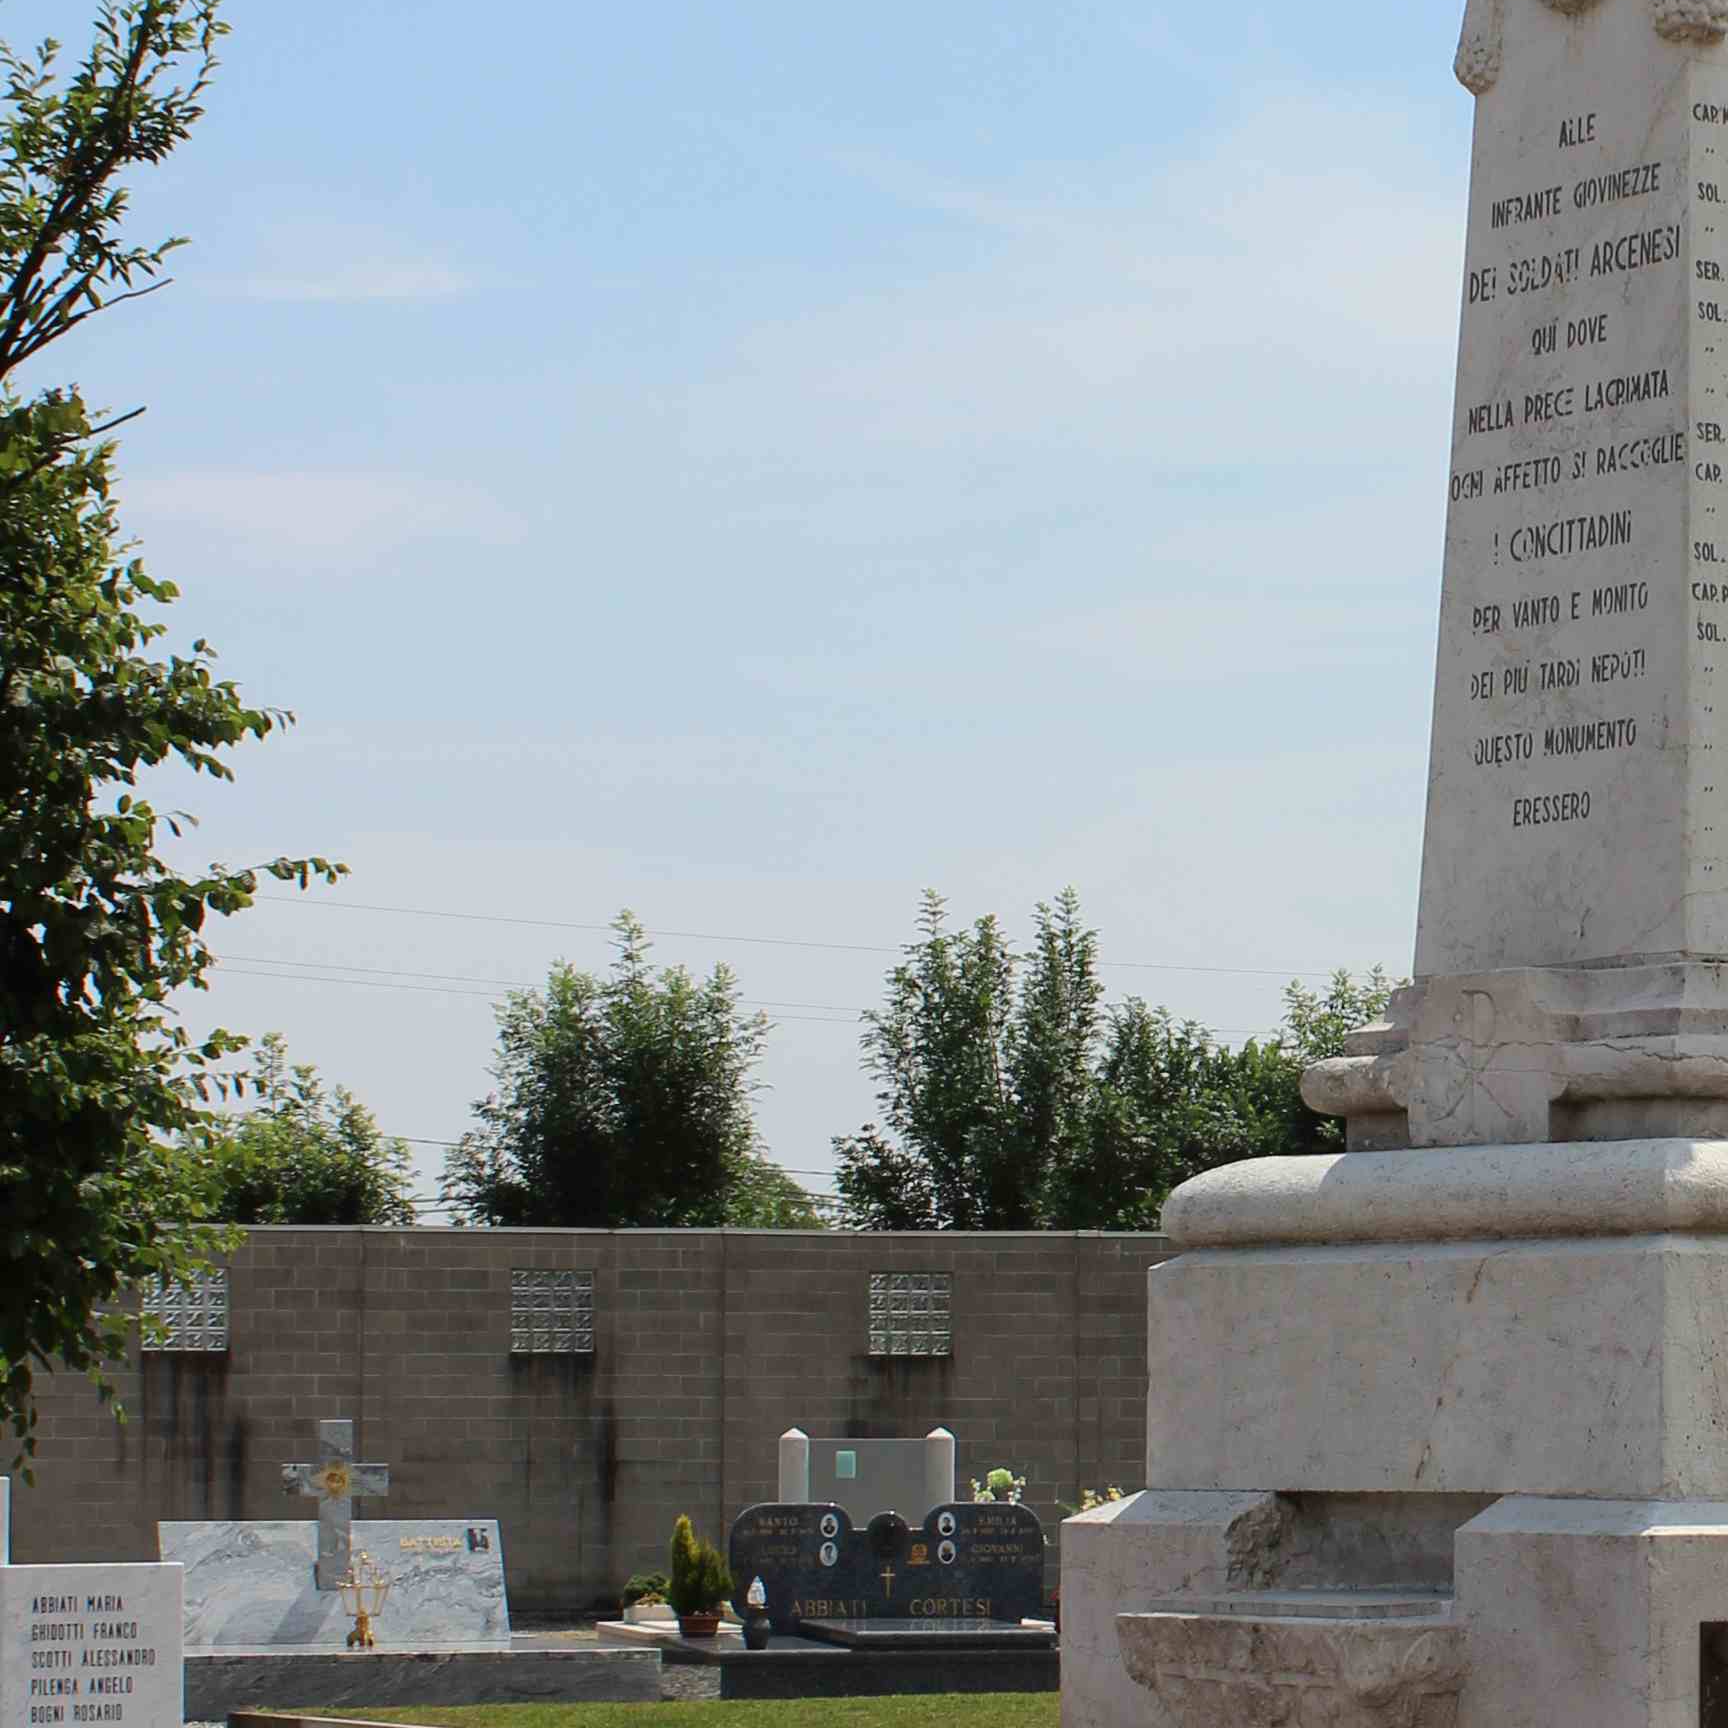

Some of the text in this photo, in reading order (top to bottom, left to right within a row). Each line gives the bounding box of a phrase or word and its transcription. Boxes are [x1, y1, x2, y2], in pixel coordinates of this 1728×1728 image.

[1559, 114, 1596, 148] ALLE
[1492, 163, 1661, 228] INFRANTE GIOVINEZZE
[1591, 225, 1680, 276] ARCENESI
[1568, 315, 1607, 348] DOVE
[1469, 401, 1513, 435] NELLA
[1525, 388, 1574, 423] PRECE
[1494, 456, 1561, 494] AFFETTO
[1513, 596, 1559, 627] VANTO
[1572, 592, 1581, 619] E
[1471, 672, 1493, 700] DEI
[1475, 719, 1636, 765] QUESTO MONUMENTO
[1513, 792, 1590, 826] ERESSERO
[32, 1596, 123, 1613] ABBIATI MARIA
[791, 1598, 992, 1617] ABBIATI CORTESI
[32, 1622, 137, 1641] GHIDOTTI FRANCO
[32, 1649, 156, 1668] SCOTTI ALESSANDRO
[89, 1677, 133, 1694] ANGELO
[73, 1704, 122, 1721] ROSARIO
